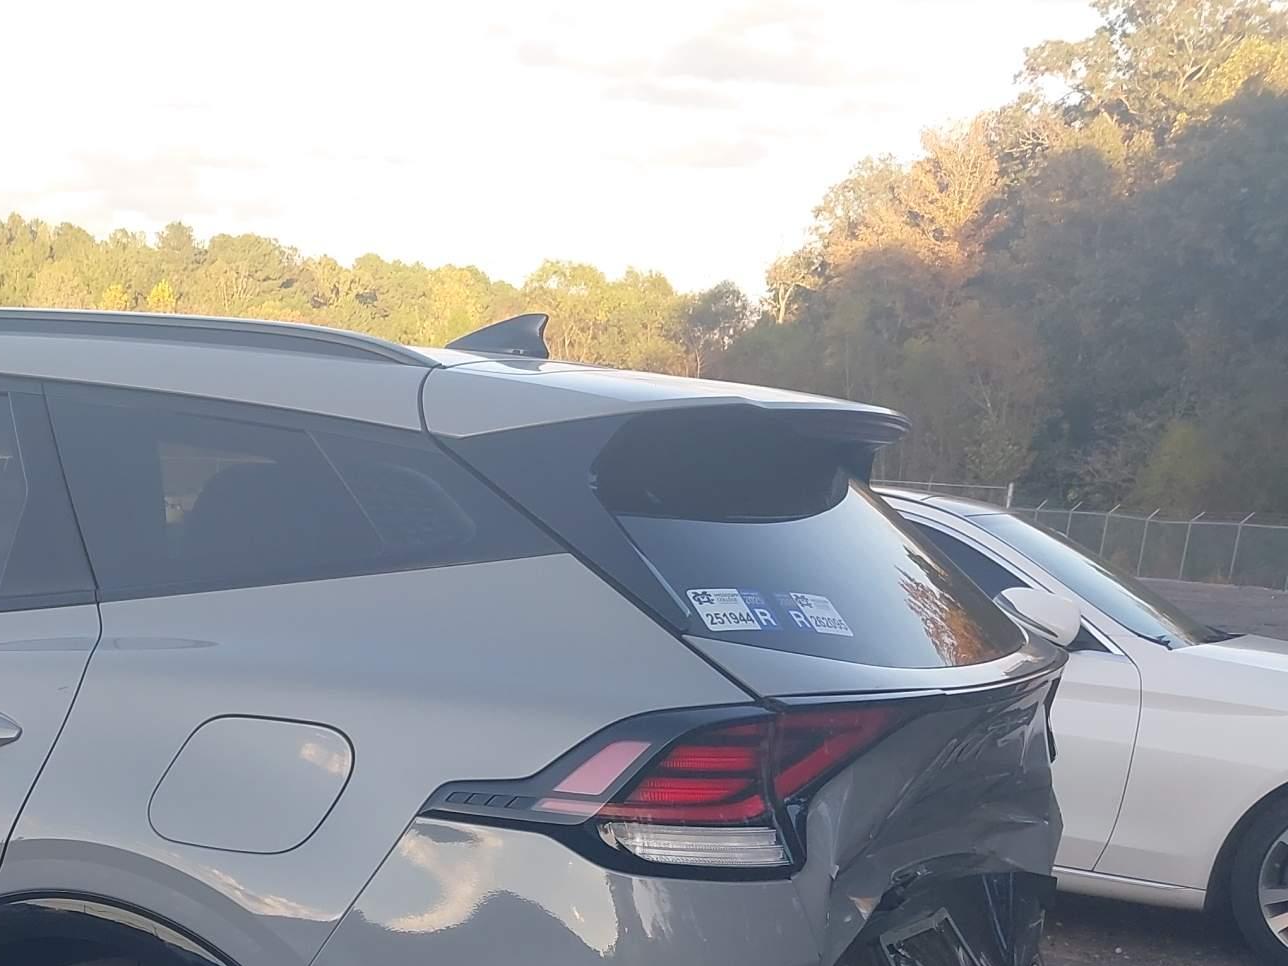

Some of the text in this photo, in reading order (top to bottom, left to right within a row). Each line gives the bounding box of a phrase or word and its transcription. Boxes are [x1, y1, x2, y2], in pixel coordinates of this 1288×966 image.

[705, 608, 777, 626] 251944 R
[789, 610, 812, 628] R
